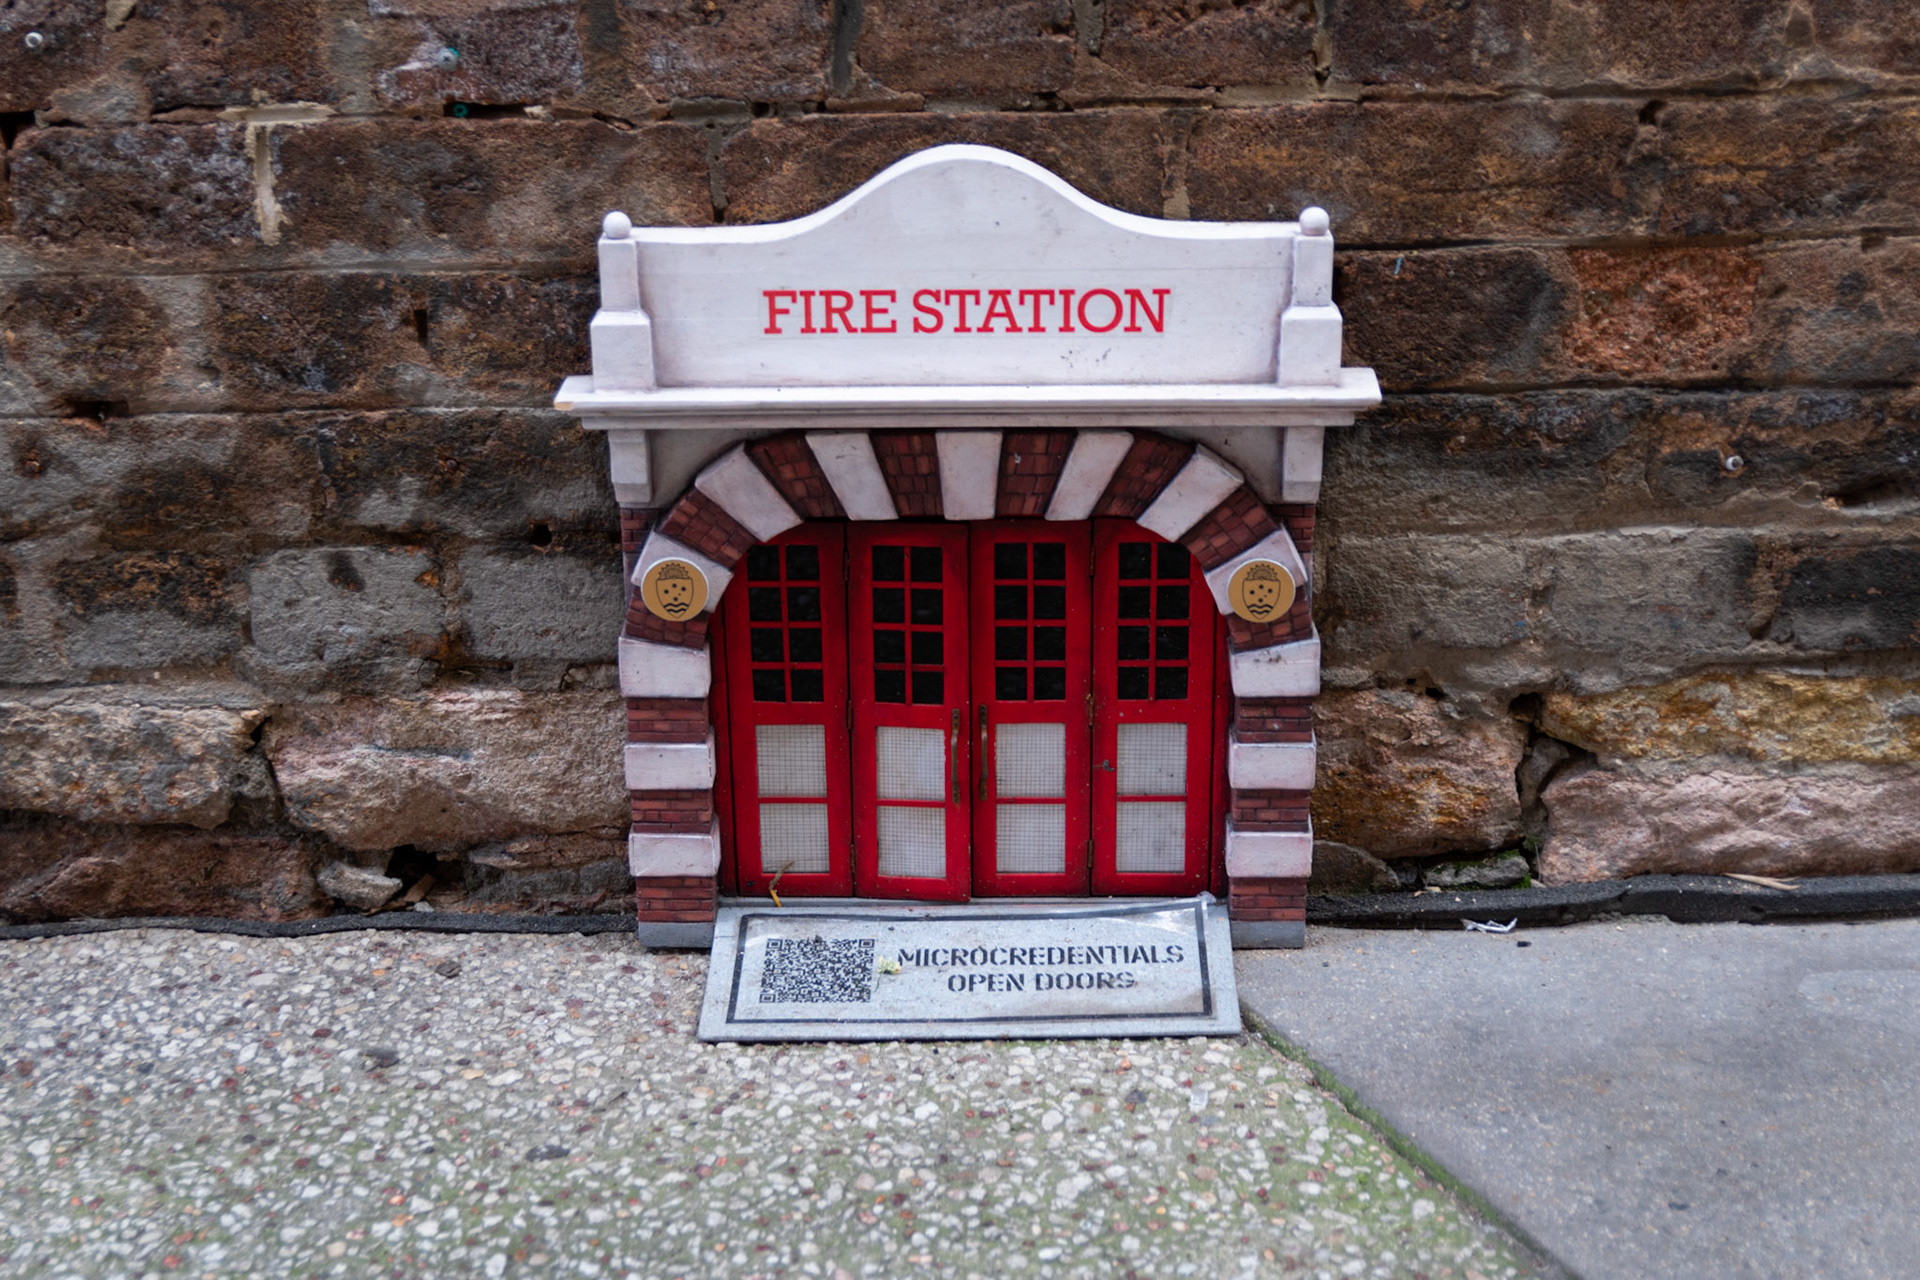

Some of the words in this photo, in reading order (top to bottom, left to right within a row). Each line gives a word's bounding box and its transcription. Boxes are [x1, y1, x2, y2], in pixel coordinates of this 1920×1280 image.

[762, 289, 898, 335] FIRE
[911, 287, 1172, 334] STATION
[899, 945, 1185, 967] MICROCREDENTIALS
[948, 973, 1026, 992] OPEN
[1035, 971, 1136, 991] DOORS
